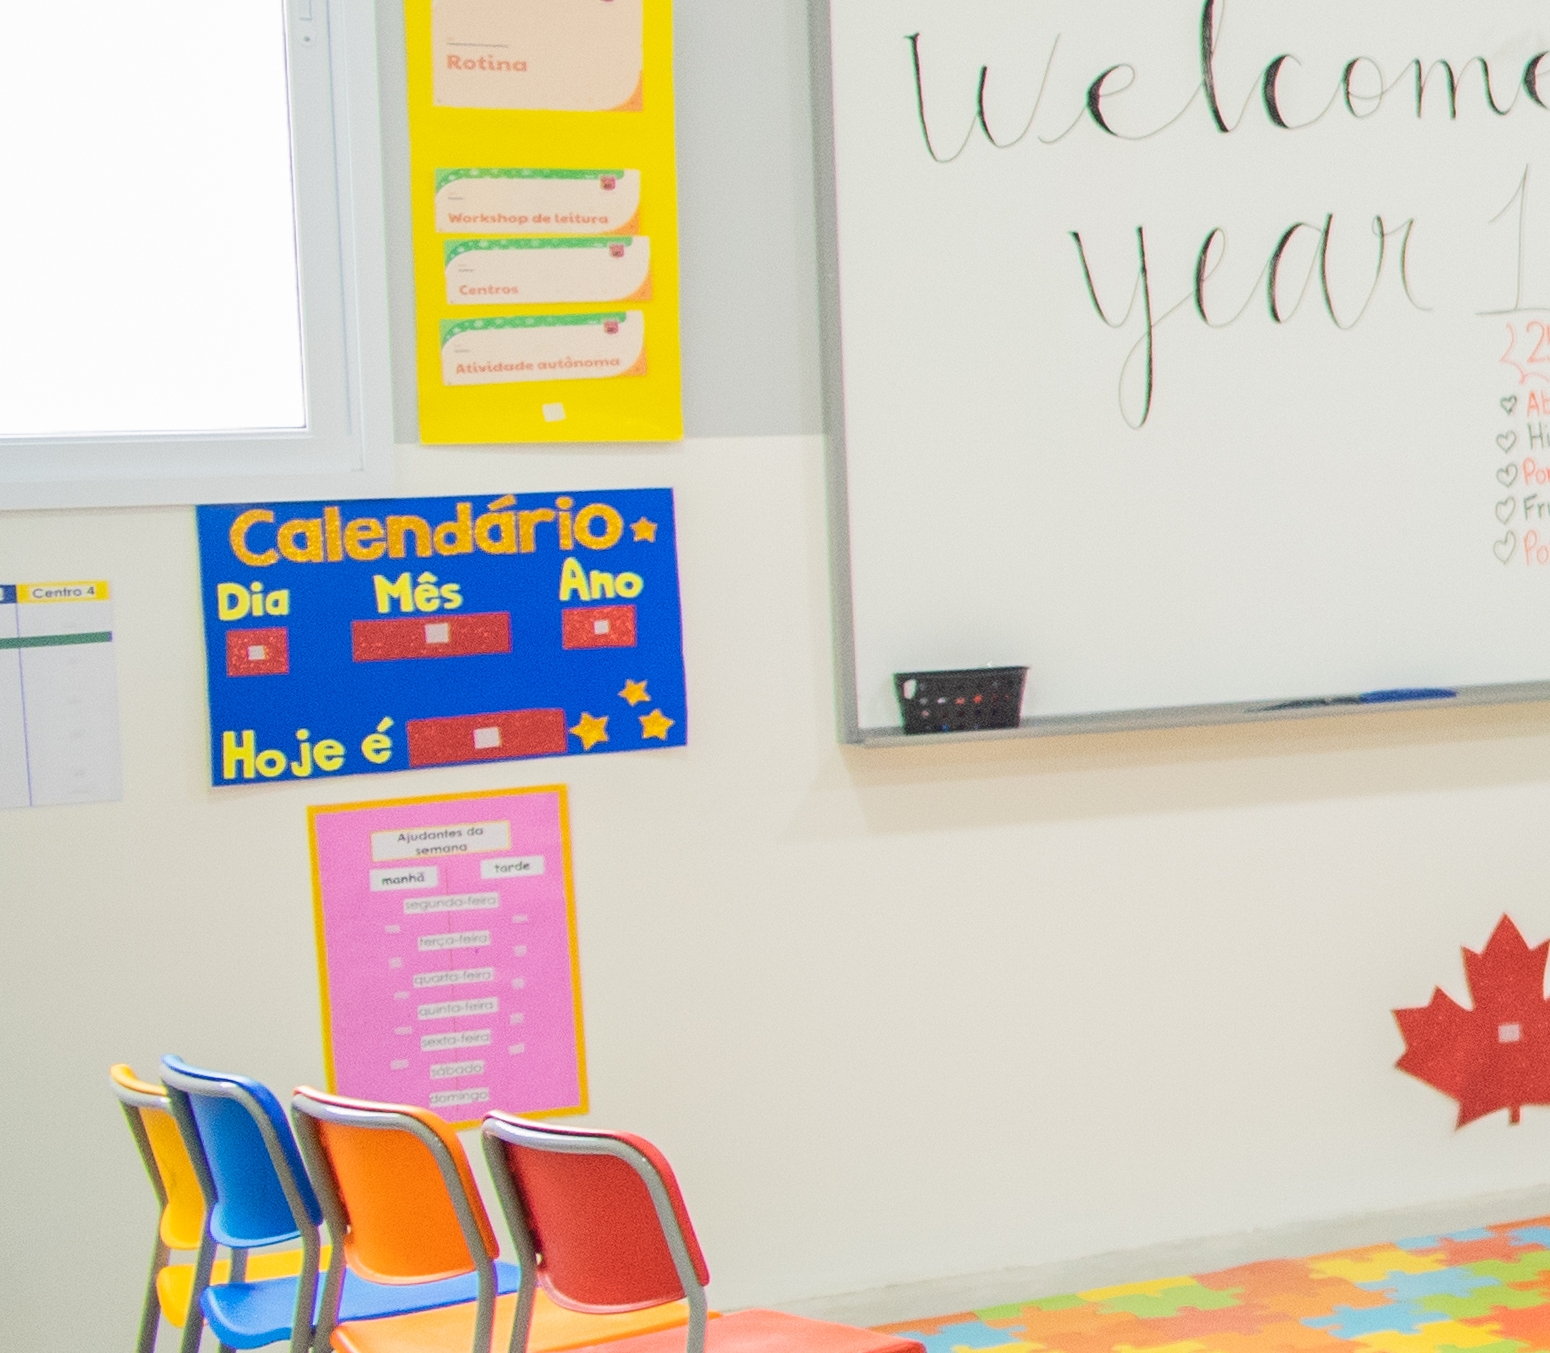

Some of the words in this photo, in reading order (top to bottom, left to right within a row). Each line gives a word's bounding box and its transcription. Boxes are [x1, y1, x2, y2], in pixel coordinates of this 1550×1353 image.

[446, 54, 528, 72] Rotina
[447, 213, 527, 227] Workshop
[532, 213, 552, 224] de
[555, 213, 609, 224] leitura
[458, 284, 519, 296] Centros
[1068, 212, 1434, 430] year
[455, 361, 534, 374] Atividade
[537, 357, 621, 371] autônoma
[230, 494, 624, 566] Calendário
[32, 587, 82, 599] Centro
[87, 586, 95, 595] 4
[217, 583, 289, 621] Dia
[373, 571, 463, 614] Mês
[559, 557, 644, 601] Ano
[222, 729, 345, 779] Hoje
[361, 717, 395, 764] é
[397, 828, 462, 843] Ajudantes
[467, 827, 484, 837] da
[416, 844, 468, 856] semana
[381, 872, 425, 885] manhã
[494, 862, 530, 873] tarde
[404, 896, 497, 912] segunda-feira
